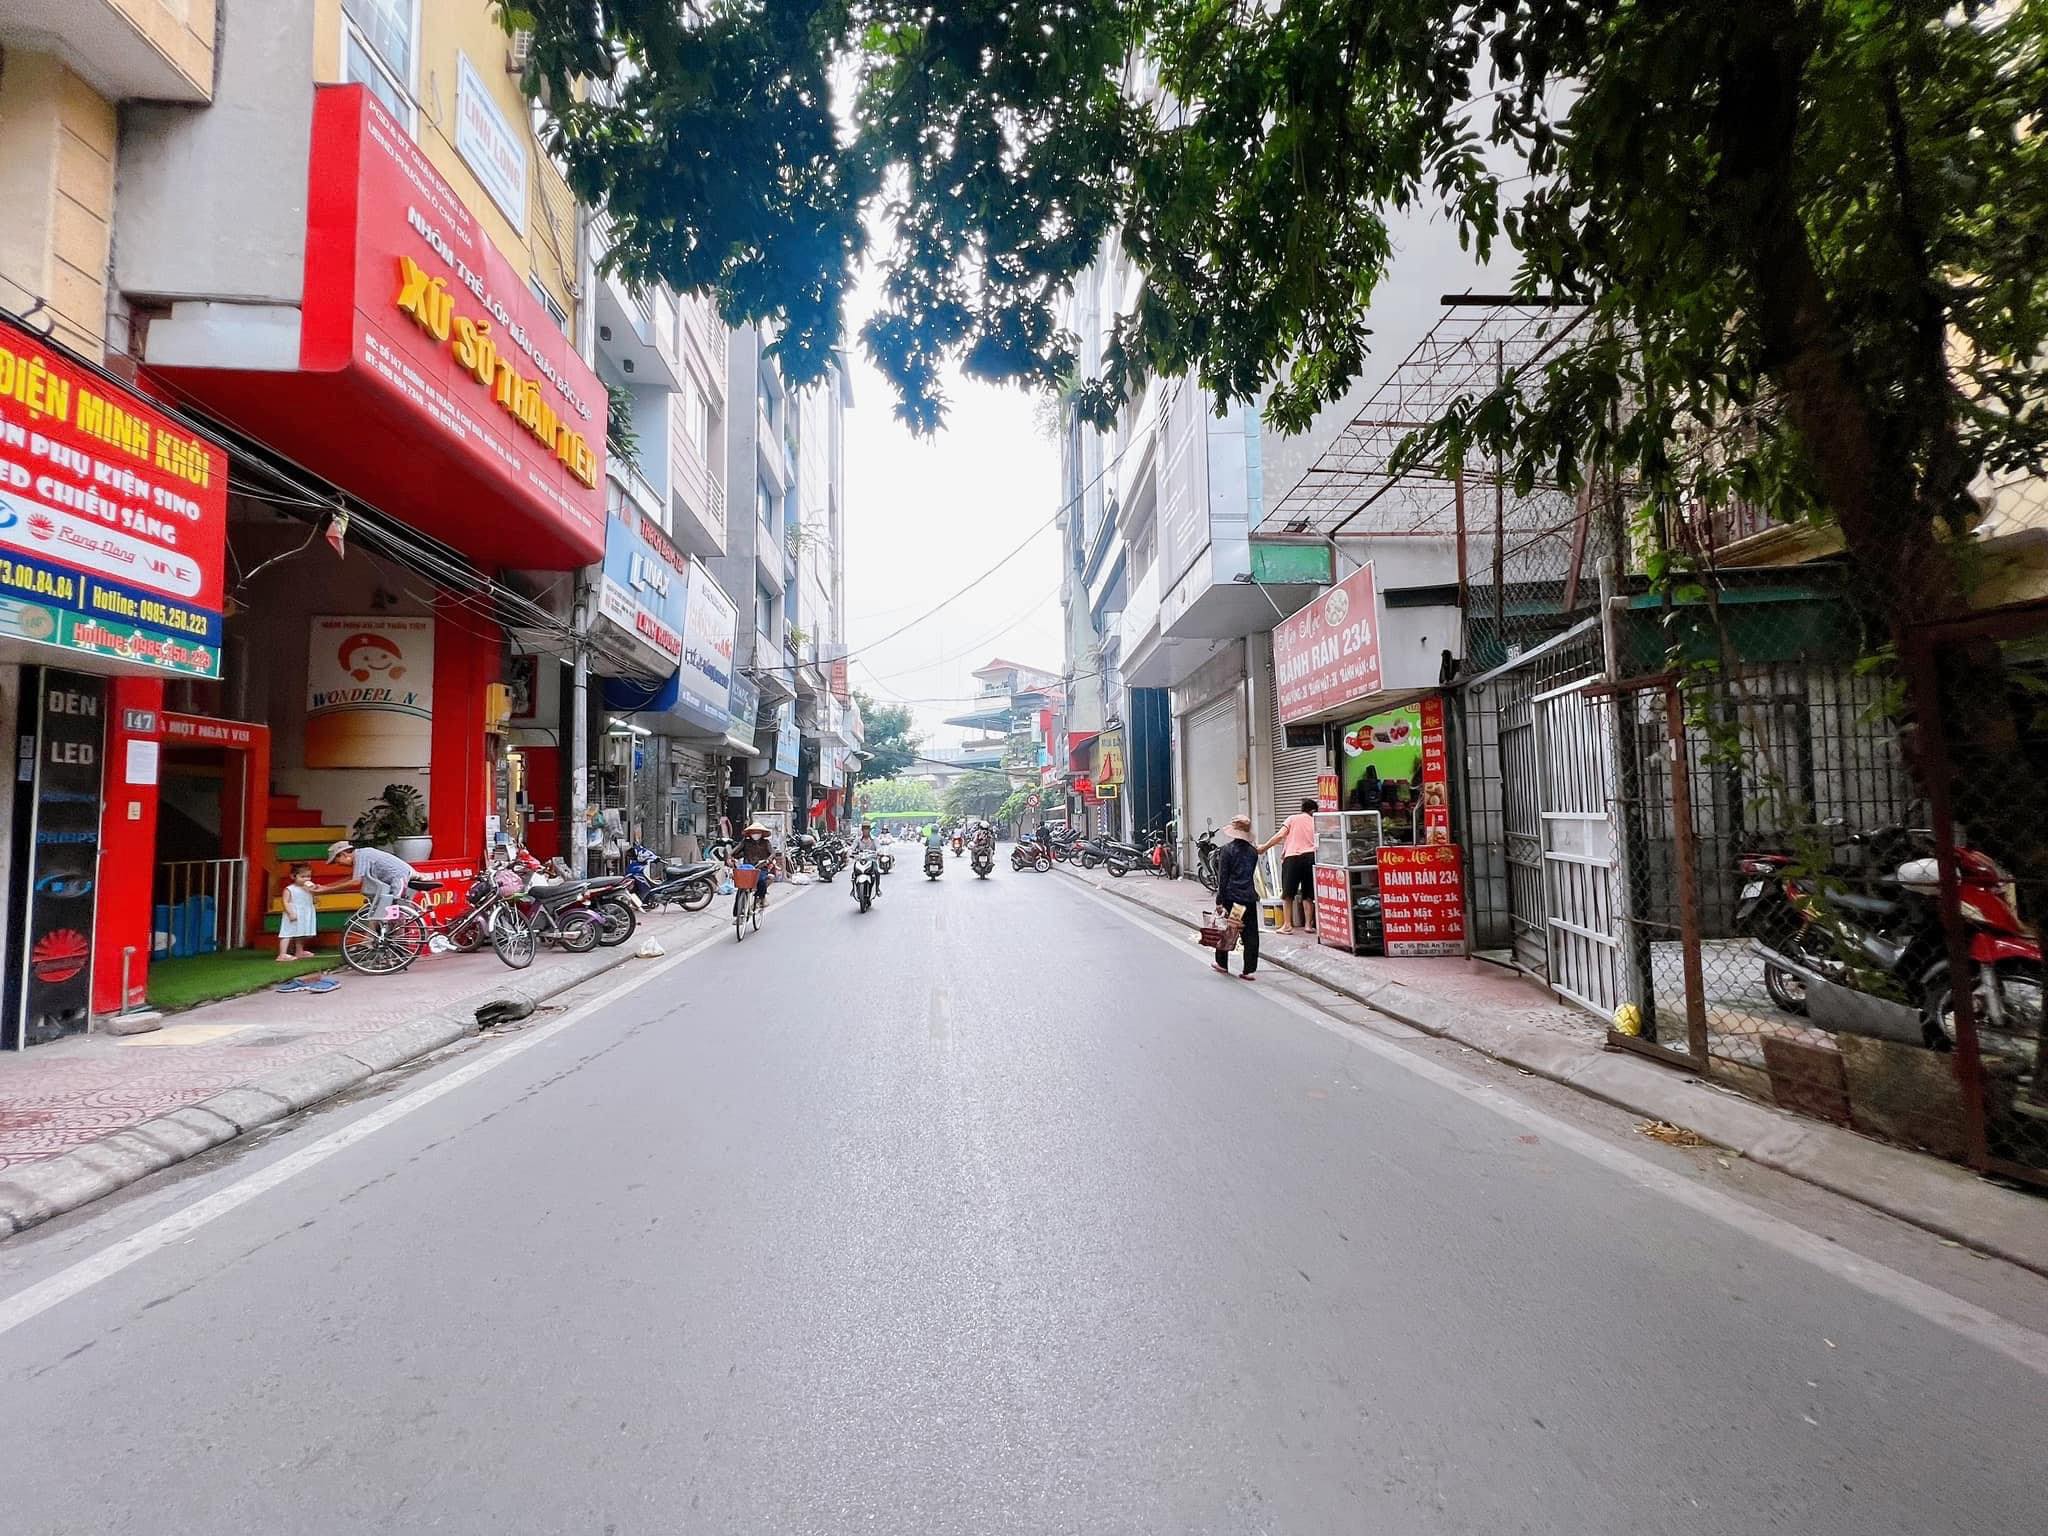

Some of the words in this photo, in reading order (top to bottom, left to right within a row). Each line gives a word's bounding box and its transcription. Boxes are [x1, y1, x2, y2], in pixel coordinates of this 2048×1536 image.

[408, 205, 455, 268] NHÓM
[394, 255, 455, 342] XỨ
[451, 315, 497, 387] SỞ
[491, 356, 558, 451] THẦN
[77, 386, 150, 461] MINH
[156, 428, 210, 490] KHÔI
[30, 431, 90, 479] PHỤ
[94, 460, 150, 500] KIỆN
[153, 486, 200, 521] SINO
[36, 475, 117, 522] CHIẾU
[120, 507, 176, 545] SÁNG
[642, 555, 671, 600] INAX
[92, 585, 138, 618] Hotline:
[1279, 653, 1309, 686] BÁNH
[1311, 635, 1340, 671] RÁN
[1342, 618, 1372, 656] 234
[126, 711, 153, 731] 147
[50, 741, 95, 766] LED
[1426, 761, 1442, 772] 234
[1383, 869, 1413, 886] BÁNH
[1415, 868, 1438, 885] RÁN
[1439, 870, 1459, 885] 234
[1383, 893, 1410, 904] Bánh
[1384, 908, 1412, 919] Bánh
[1385, 922, 1412, 934] Bánh
[1414, 922, 1436, 935] Mặn
[1447, 922, 1462, 933] 4k
